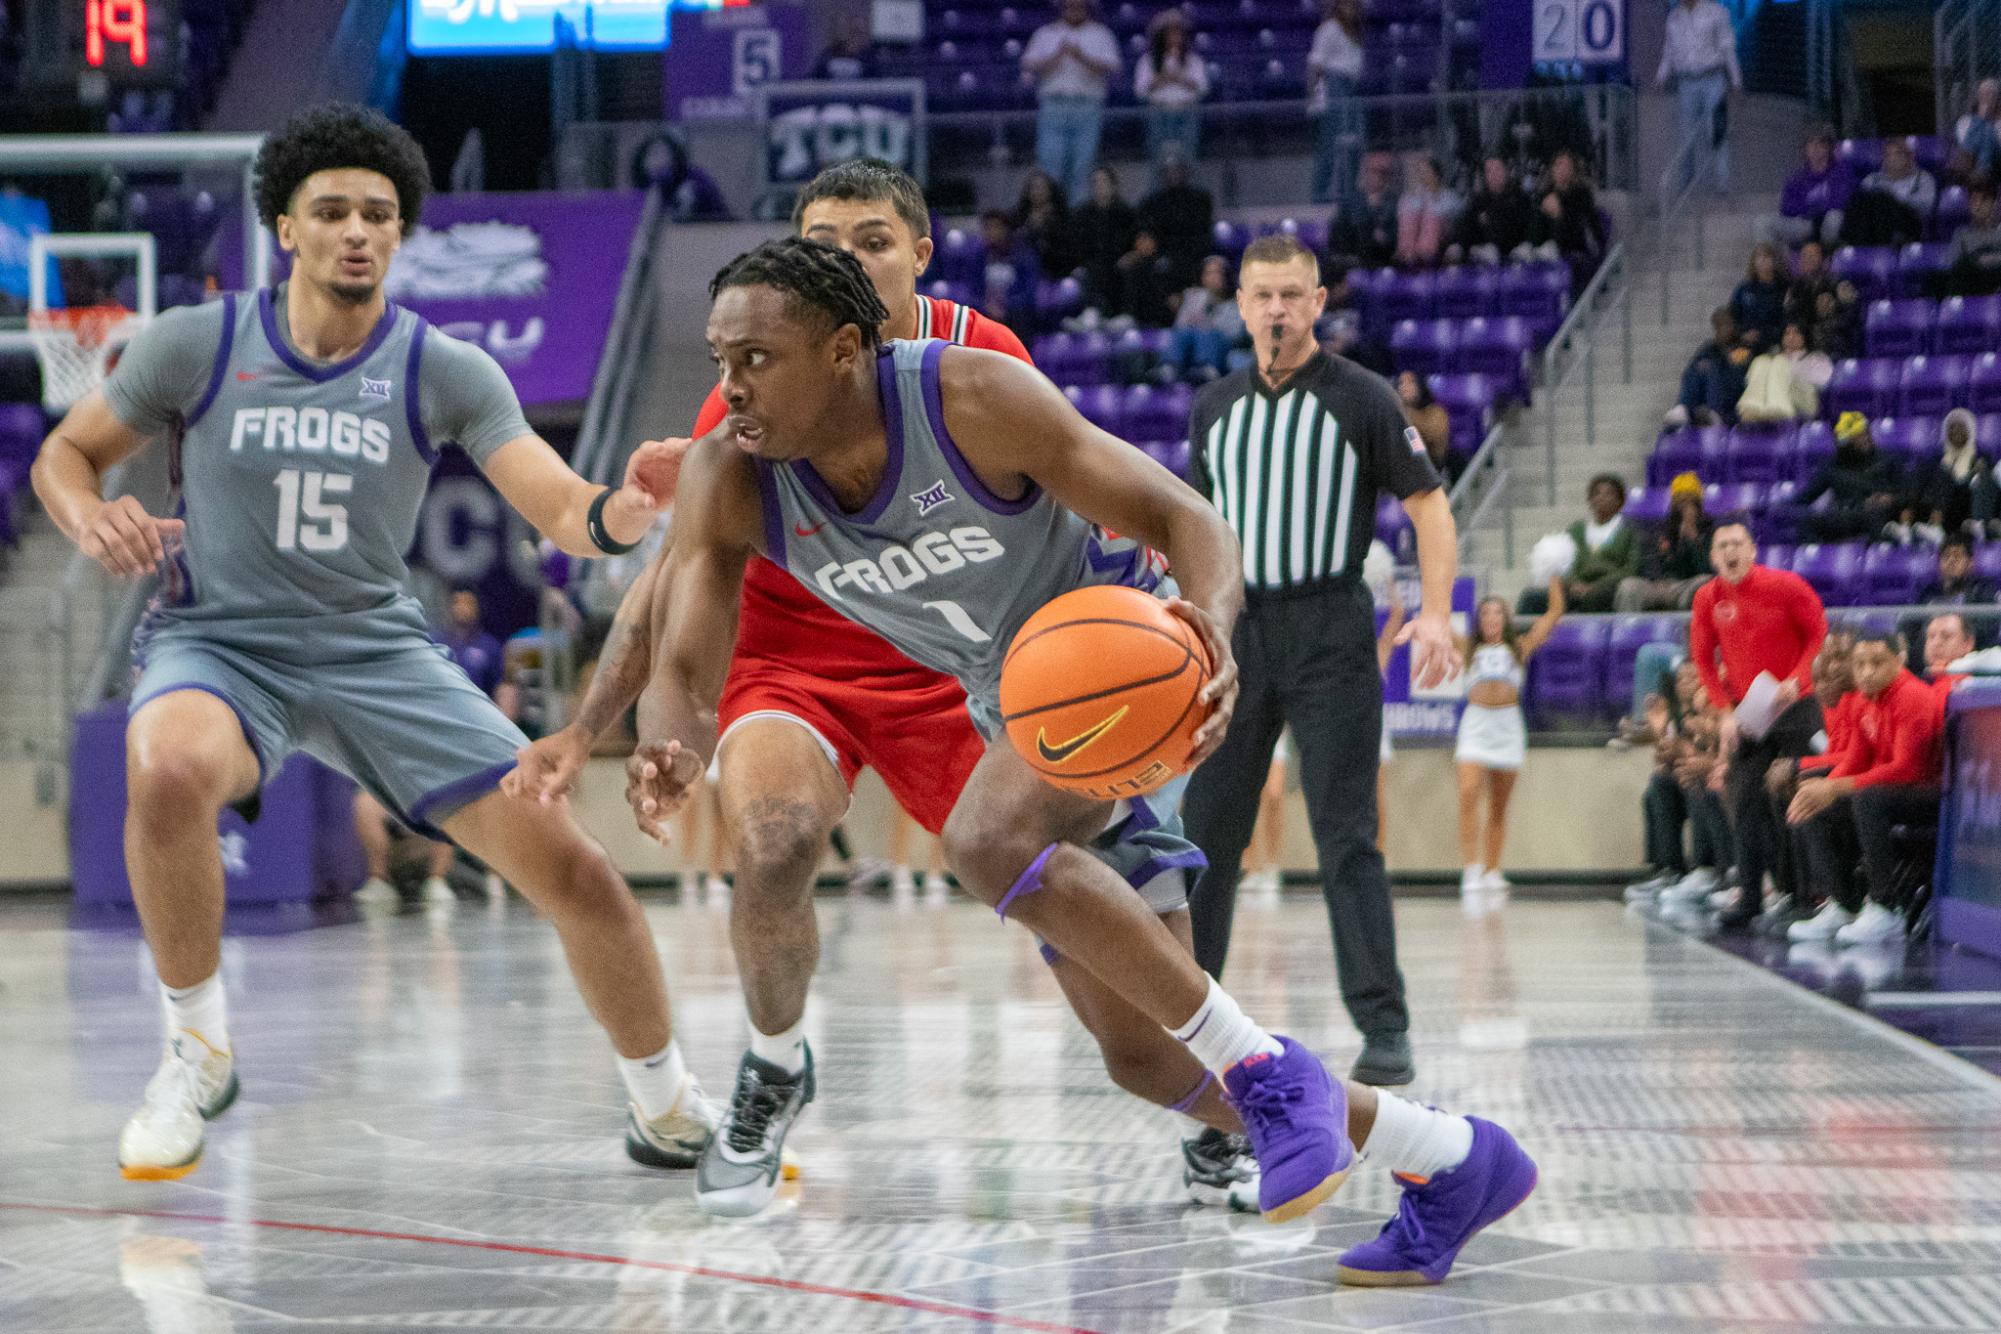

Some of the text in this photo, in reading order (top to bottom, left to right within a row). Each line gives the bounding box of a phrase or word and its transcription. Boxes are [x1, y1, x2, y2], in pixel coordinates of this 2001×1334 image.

[86, 0, 147, 67] 19
[743, 37, 770, 85] 5
[771, 104, 910, 178] TCU
[230, 406, 391, 464] FROGS
[272, 468, 354, 552] 15
[814, 526, 1006, 600] FROGS
[922, 600, 992, 642] 1
